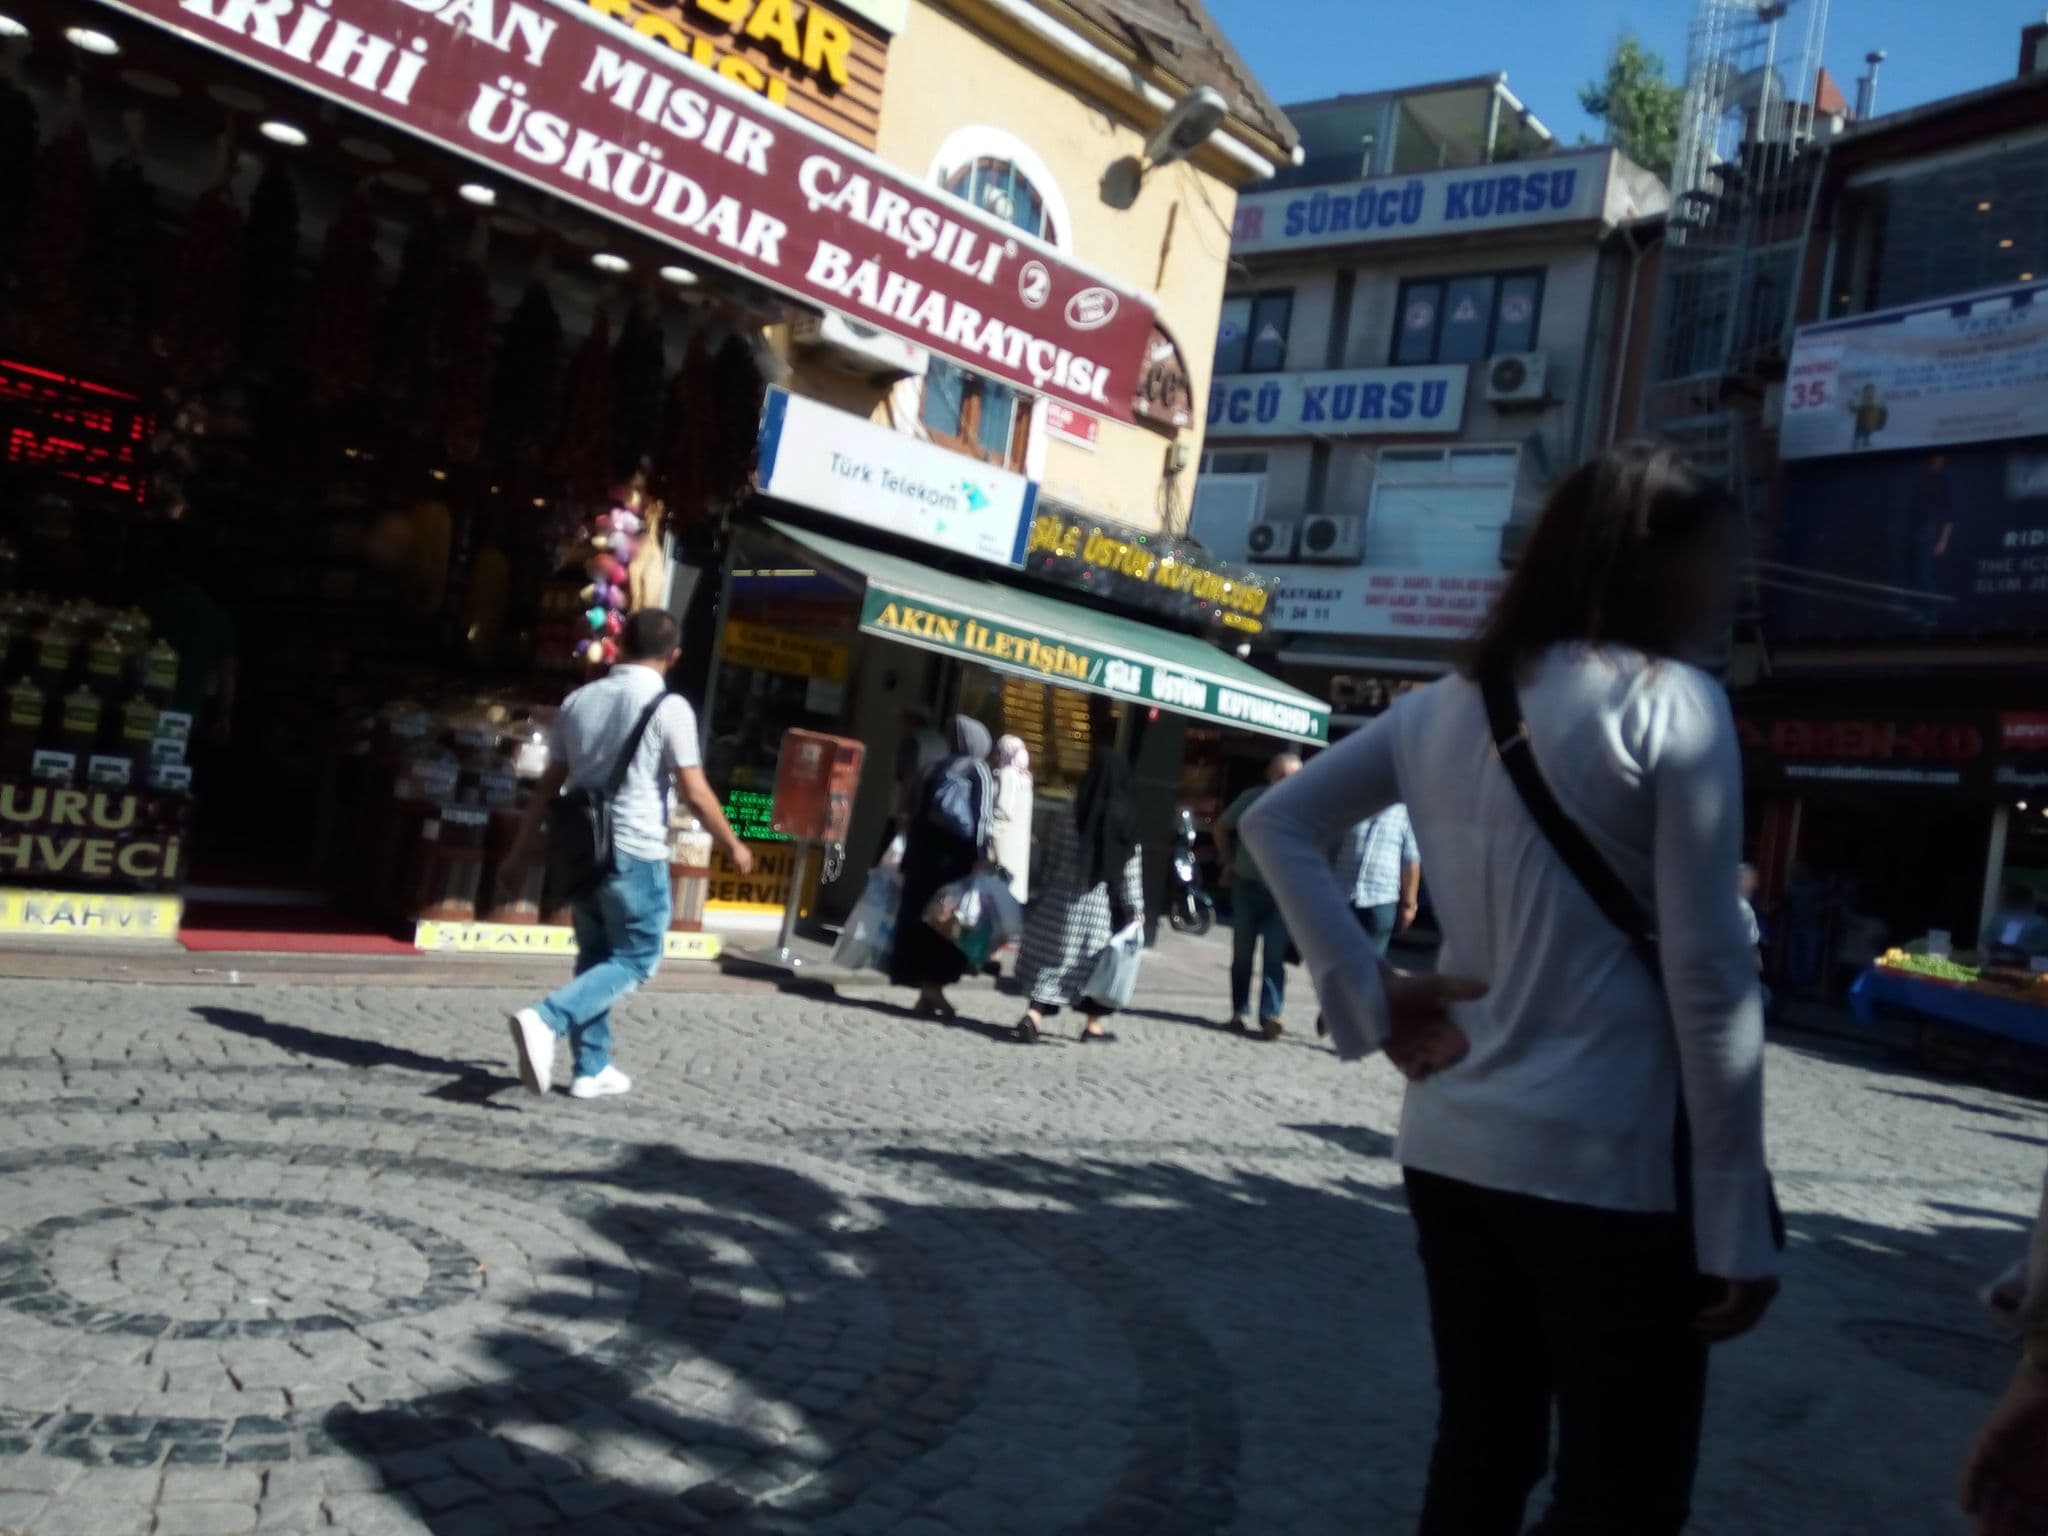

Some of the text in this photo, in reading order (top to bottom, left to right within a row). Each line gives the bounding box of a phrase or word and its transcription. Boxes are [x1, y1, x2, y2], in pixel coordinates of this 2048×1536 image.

[580, 45, 776, 175] MISIR
[798, 155, 1003, 285] ÇARŞILI
[1284, 179, 1427, 238] SÜRÜCÜ
[1444, 169, 1578, 222] KURSU
[467, 75, 788, 267] ÜSKÜDAR
[806, 240, 1110, 404] BAHARATÇISI
[1300, 378, 1450, 424] KURSU
[1791, 382, 1825, 408] 35
[830, 452, 958, 511] Türk Telekom
[876, 602, 959, 643] AKIN
[964, 620, 1090, 679] İLETİŞİM
[1, 784, 137, 829] URU
